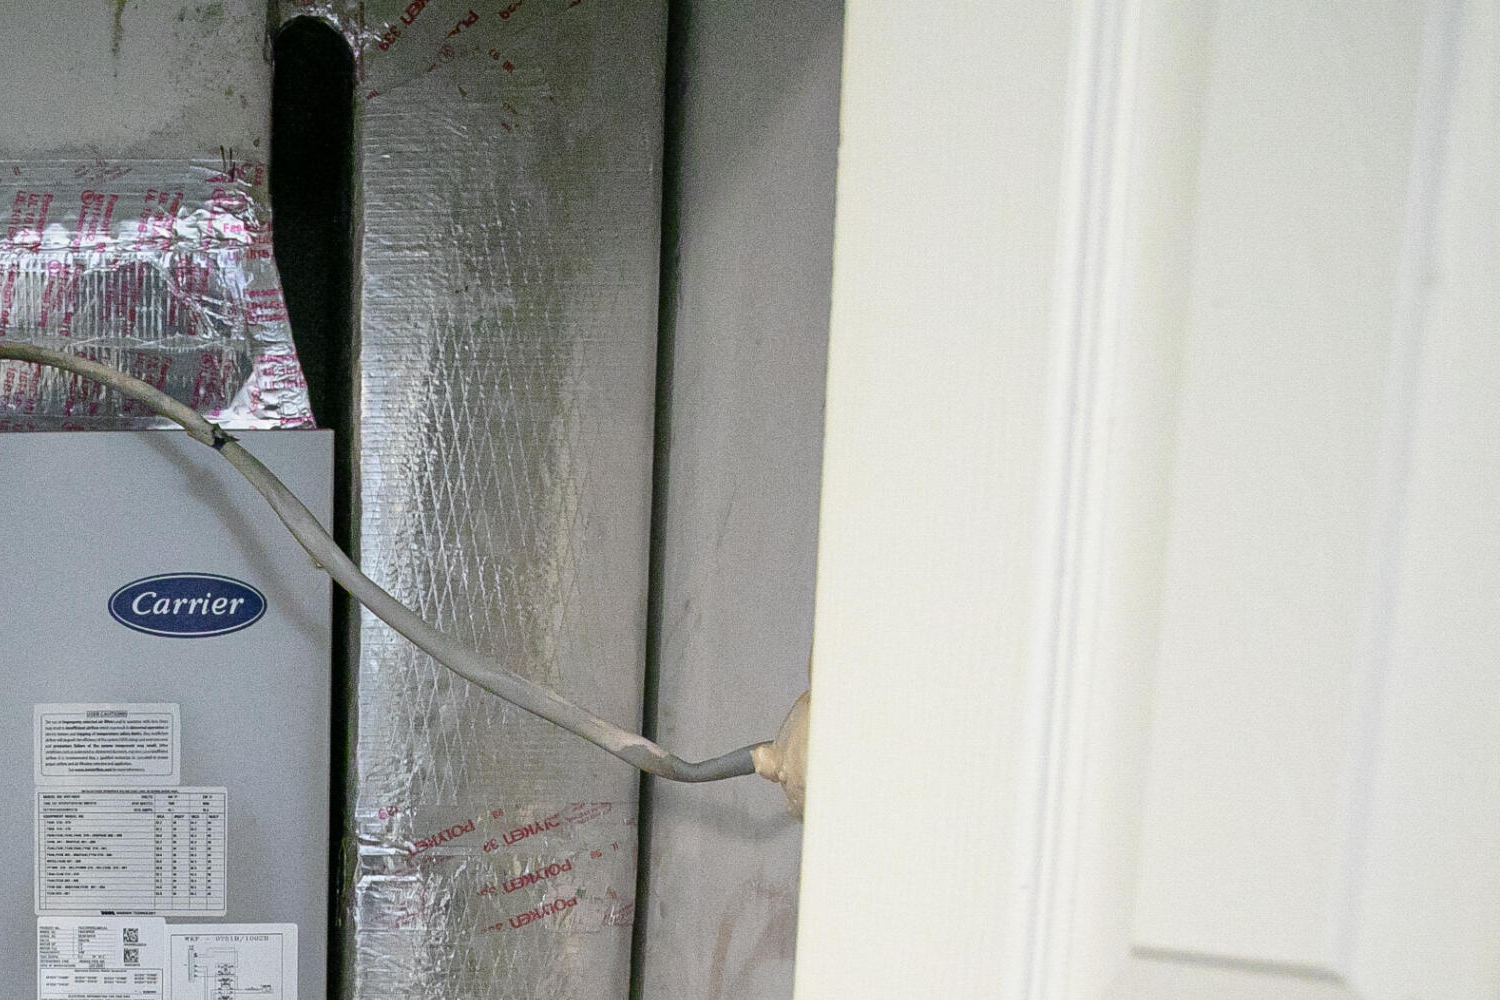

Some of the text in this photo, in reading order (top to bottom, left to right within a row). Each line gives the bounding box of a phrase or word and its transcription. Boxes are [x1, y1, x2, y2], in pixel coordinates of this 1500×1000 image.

[131, 591, 245, 616] Carrier
[503, 859, 573, 894] POLYKEN
[508, 896, 578, 929] POLYKEN
